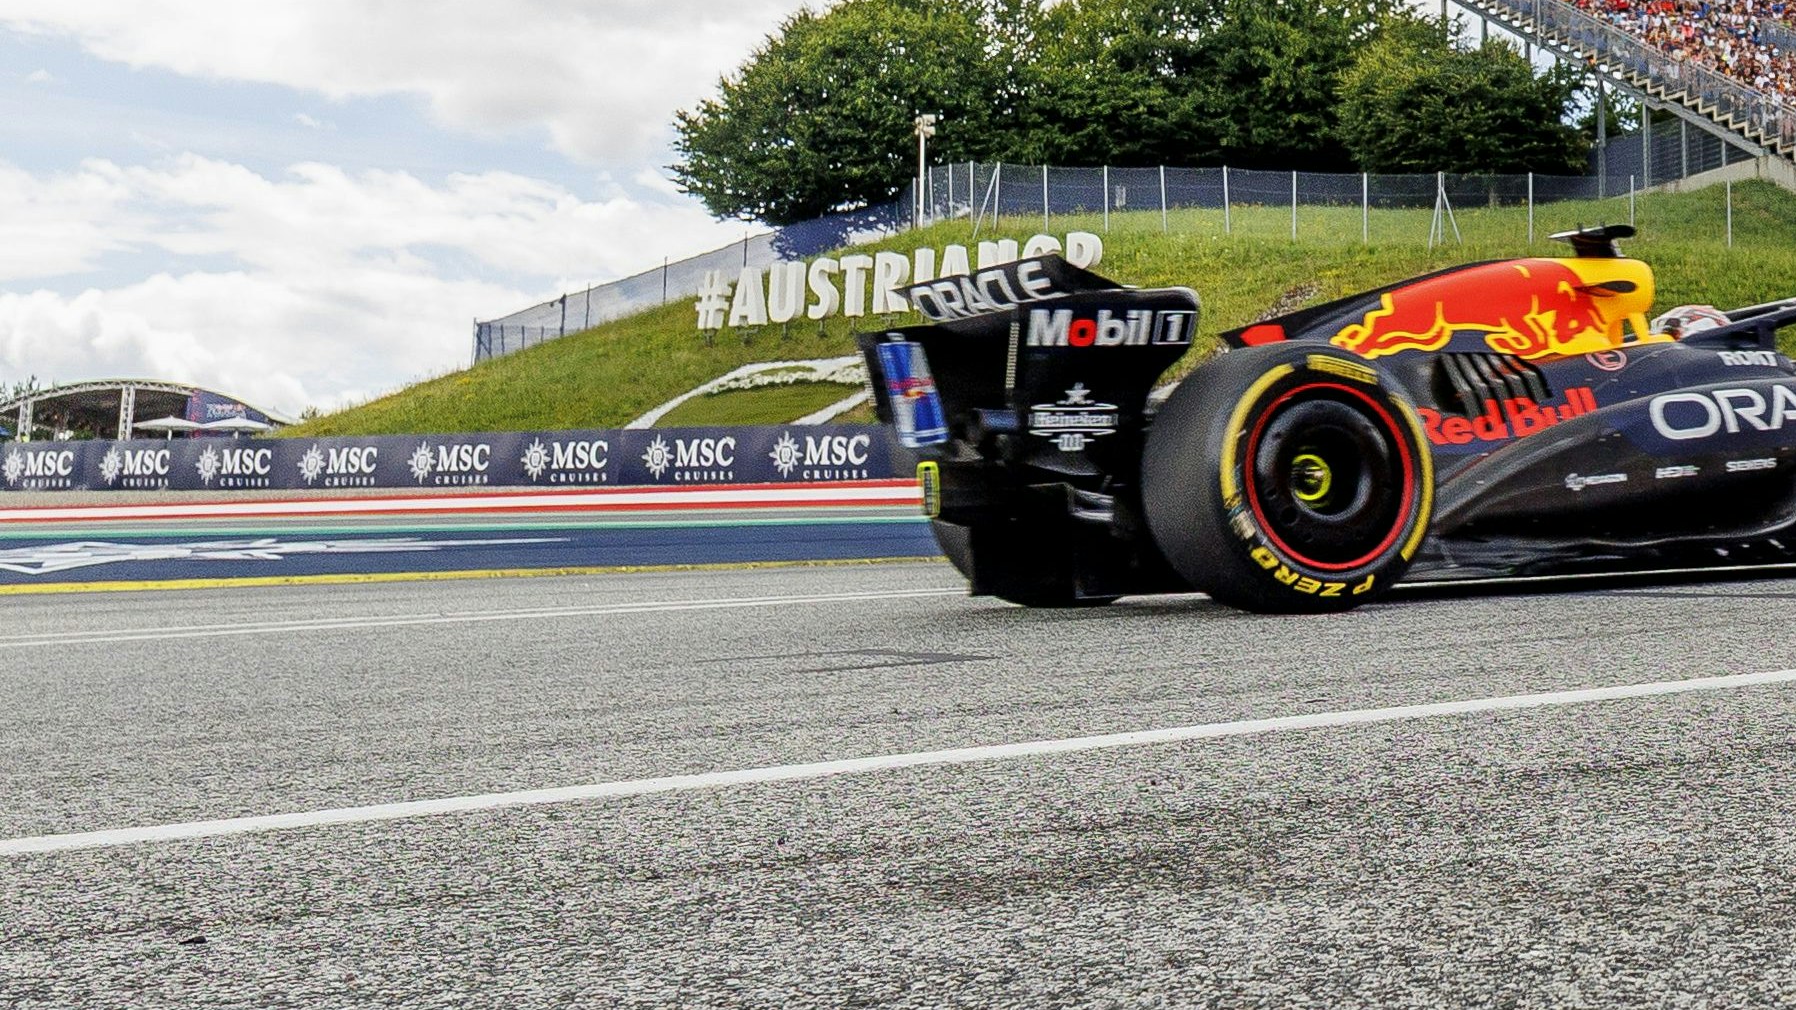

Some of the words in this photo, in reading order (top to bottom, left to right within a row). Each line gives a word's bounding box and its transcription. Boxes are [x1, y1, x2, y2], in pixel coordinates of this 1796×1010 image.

[910, 260, 1072, 321] ORACLE
[1026, 308, 1153, 347] Mobil
[1166, 313, 1185, 342] 1
[1416, 396, 1507, 445] Red
[1502, 386, 1597, 439] Bull
[24, 450, 74, 476] MSC
[122, 449, 170, 475] MSC
[220, 448, 272, 475] MSC
[325, 446, 378, 474] MSC
[436, 444, 490, 472] MSC
[551, 440, 608, 470] MSC
[674, 436, 736, 468] MSC
[803, 434, 870, 466] MSC
[674, 470, 734, 481] CRUISES
[803, 469, 869, 480] CRUISES
[1251, 546, 1347, 597] ZERO
[1352, 574, 1375, 595] P
